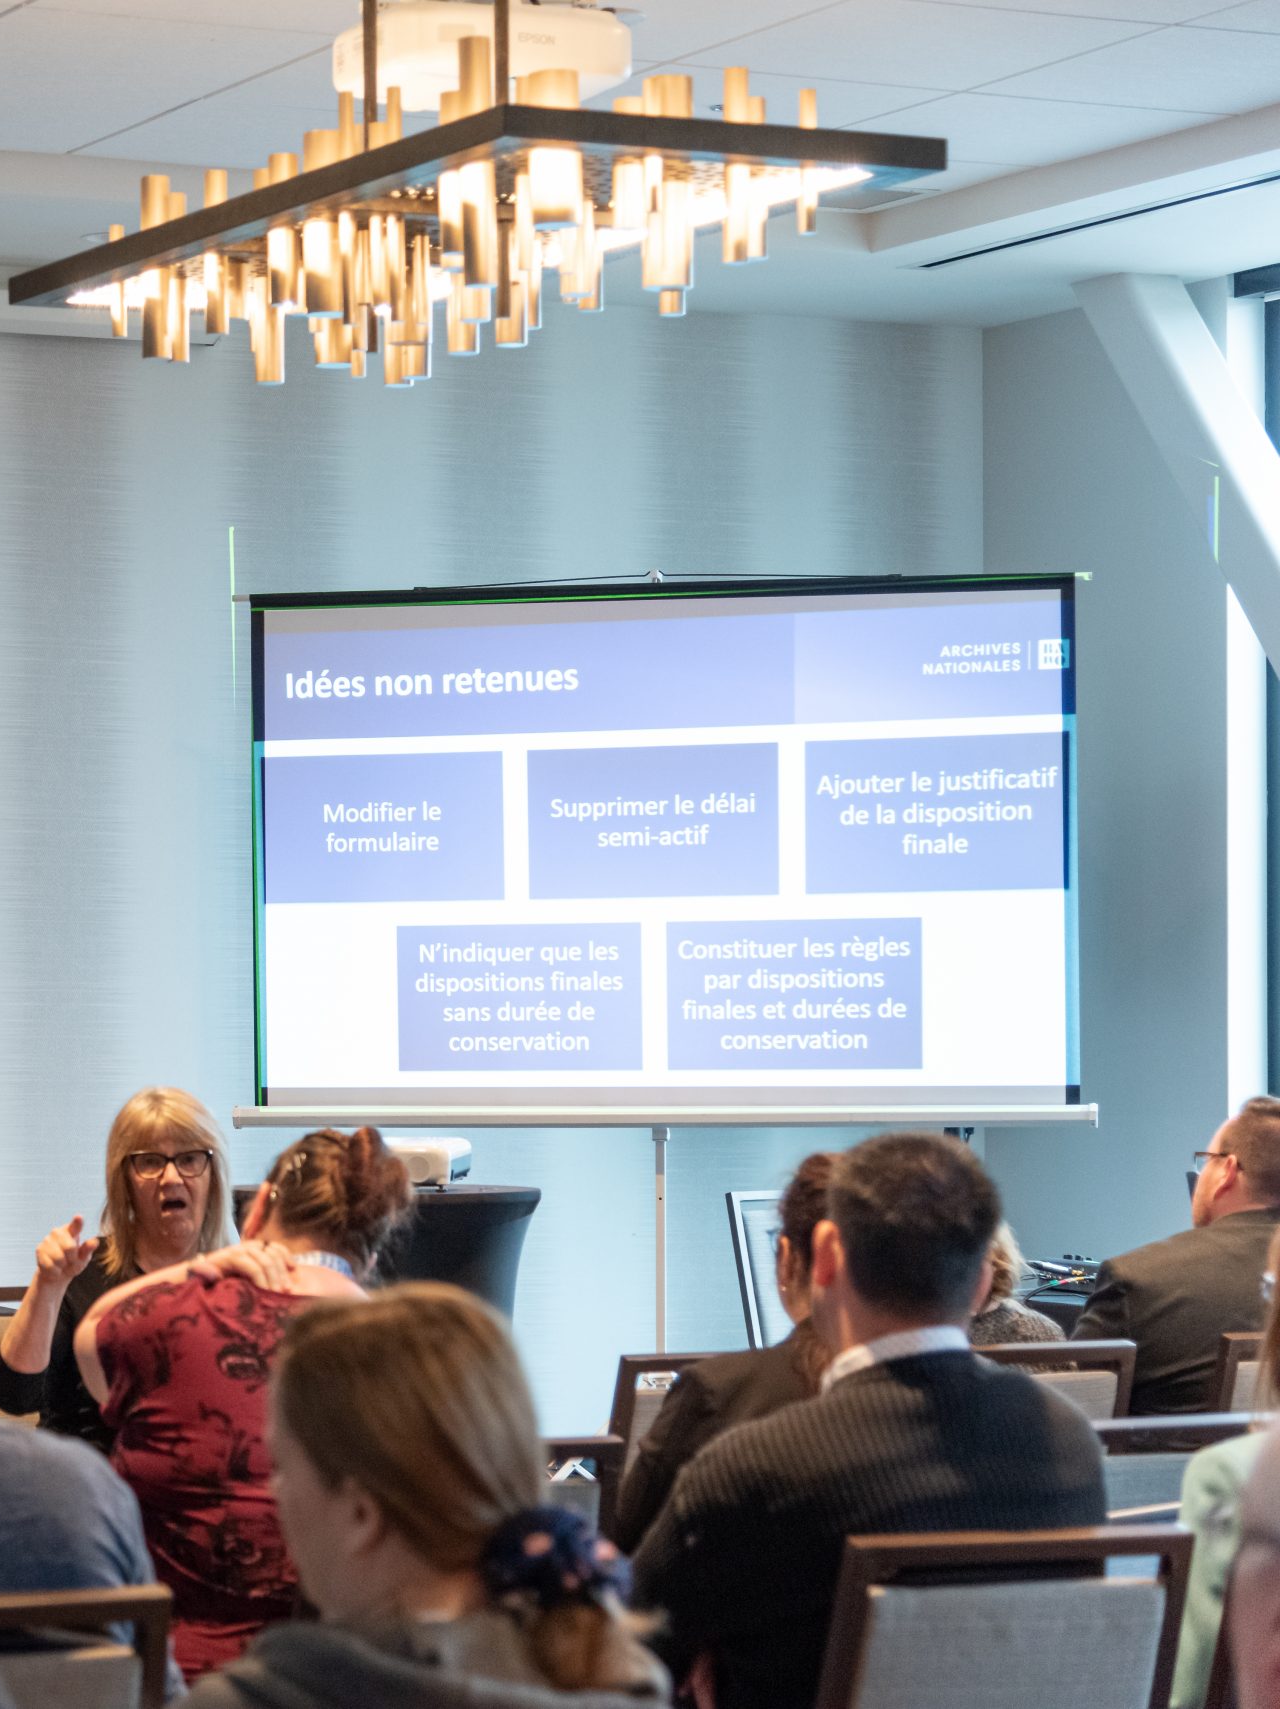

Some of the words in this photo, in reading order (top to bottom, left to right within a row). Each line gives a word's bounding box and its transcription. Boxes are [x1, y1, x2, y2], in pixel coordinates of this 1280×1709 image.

[518, 32, 556, 46] EPSON
[940, 642, 1021, 657] ARCHIVES
[922, 659, 1021, 675] NATIONALES
[286, 670, 365, 698] Idées
[375, 674, 432, 696] non
[443, 668, 579, 694] retenues
[817, 775, 905, 799] Ajouter
[912, 771, 932, 792] le
[938, 767, 1057, 797] justificatif
[323, 801, 416, 823] Modifier
[422, 800, 442, 821] le
[551, 797, 668, 821] Supprimer
[675, 794, 694, 814] le
[701, 792, 755, 814] délai
[840, 805, 869, 825] de
[876, 804, 896, 824] la
[902, 801, 1033, 827] disposition
[326, 832, 439, 852] formulaire
[598, 824, 709, 847] semi-actif
[902, 833, 968, 855] finale
[419, 943, 534, 966] N’indiquer
[540, 947, 581, 965] que
[589, 941, 619, 960] les
[678, 939, 797, 959] Constituer
[804, 937, 835, 957] les
[841, 936, 910, 961] règles
[415, 973, 544, 996] dispositions
[550, 971, 623, 991] finales
[704, 975, 741, 993] par
[748, 969, 885, 992] dispositions
[443, 1007, 491, 1022] sans
[497, 1001, 561, 1021] durée
[568, 1001, 595, 1020] de
[682, 999, 757, 1019] finales
[763, 1002, 786, 1019] et
[792, 998, 871, 1019] durées
[877, 998, 906, 1018] de
[449, 1032, 589, 1051] conservation
[720, 1030, 868, 1050] conservation
